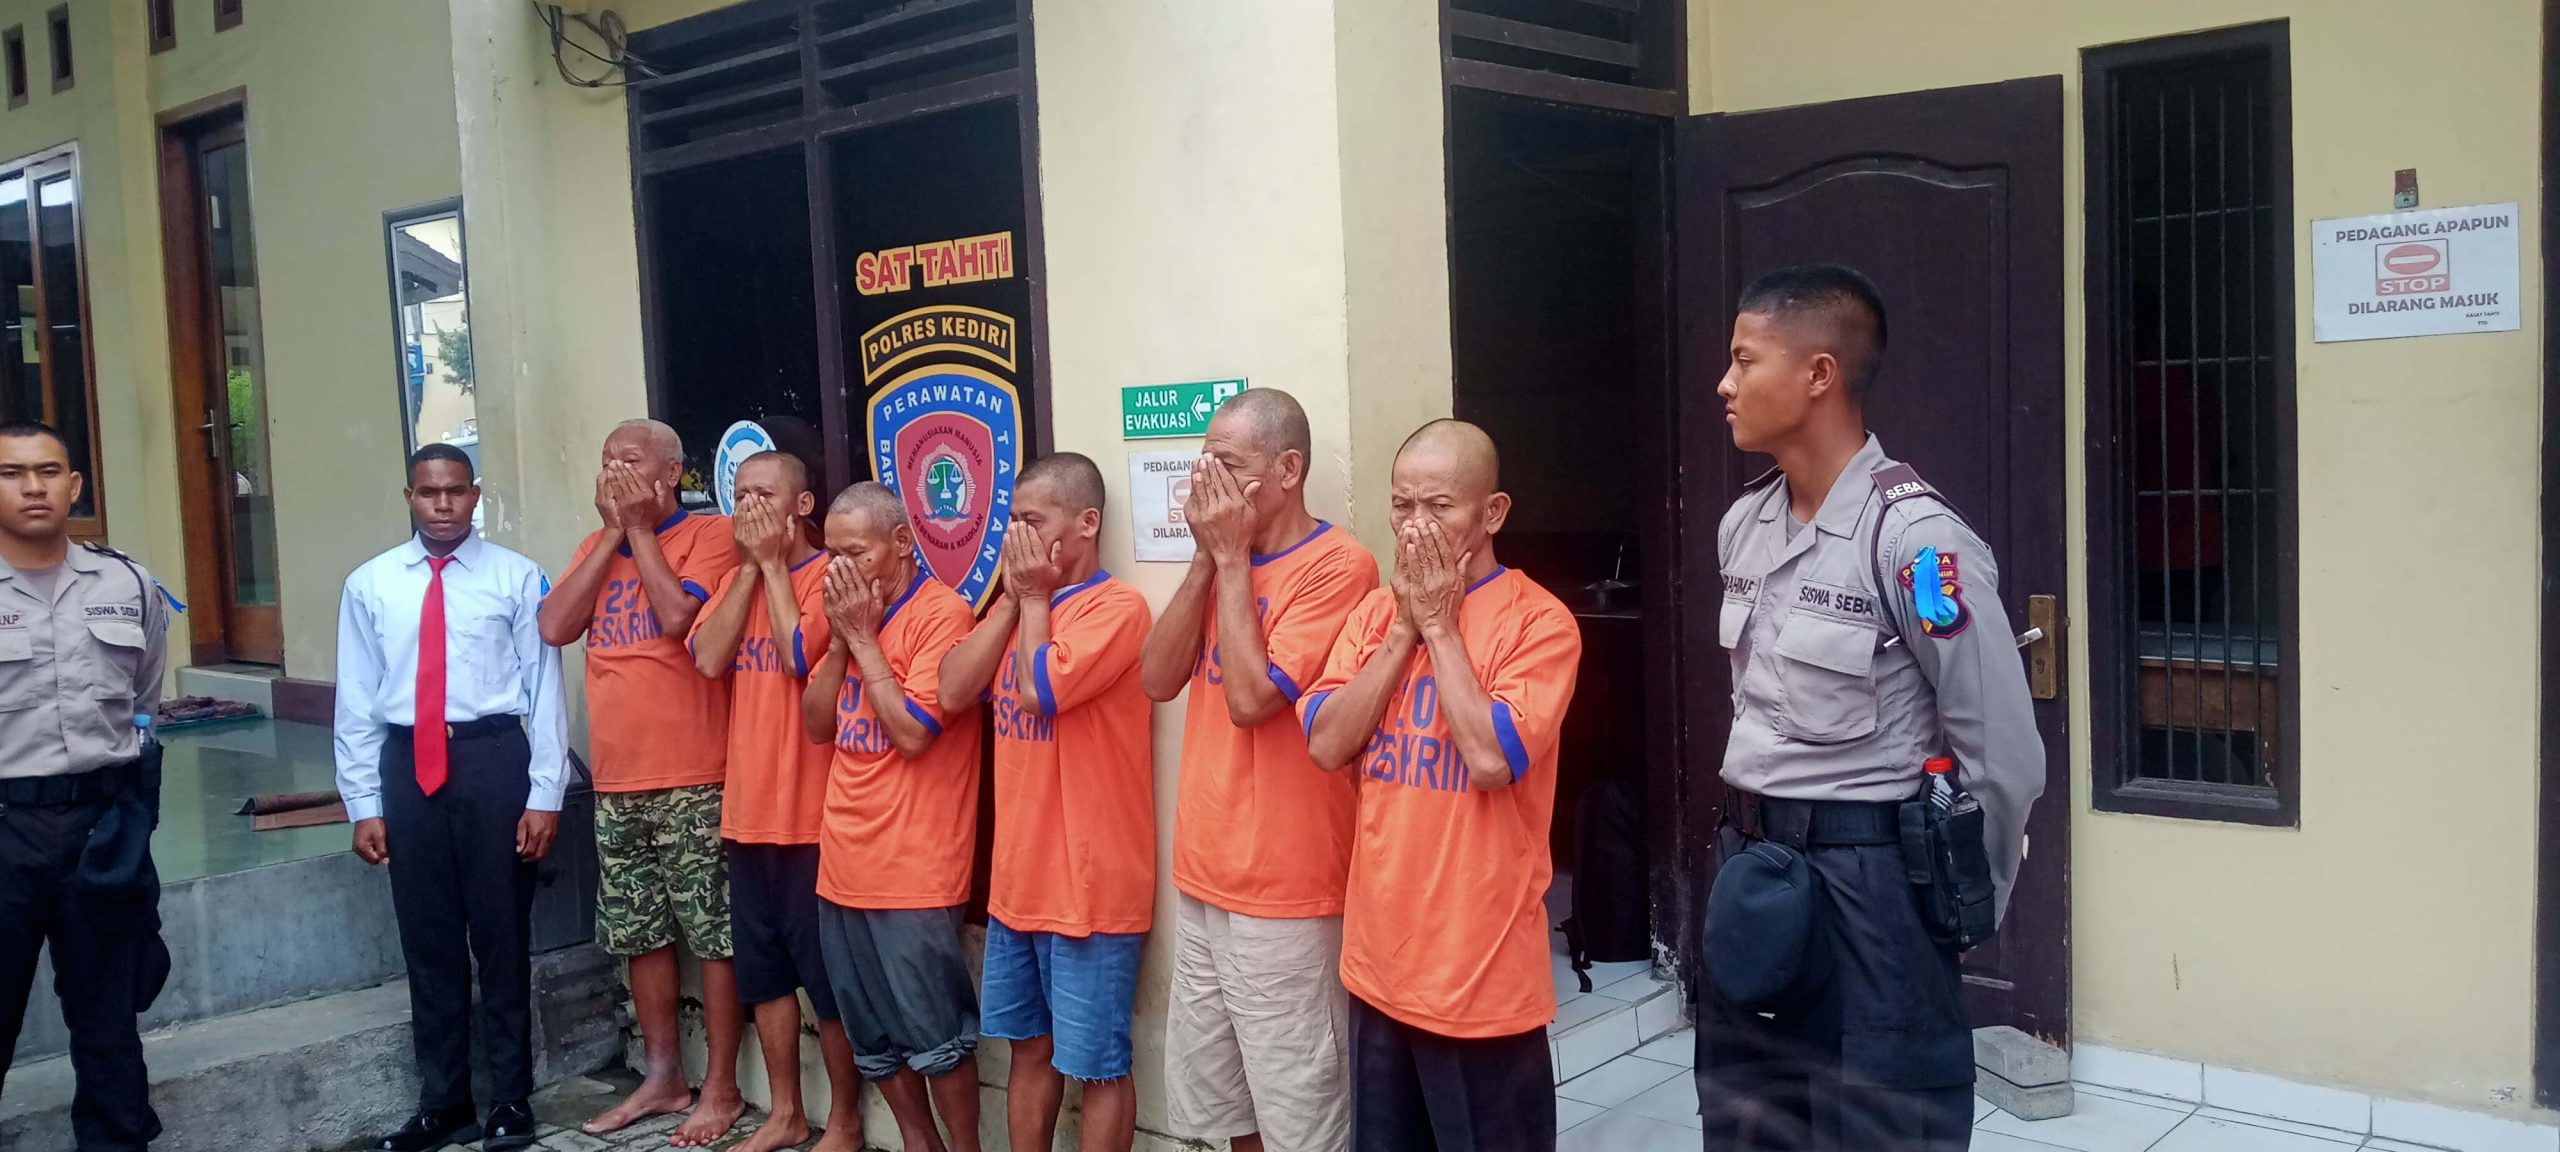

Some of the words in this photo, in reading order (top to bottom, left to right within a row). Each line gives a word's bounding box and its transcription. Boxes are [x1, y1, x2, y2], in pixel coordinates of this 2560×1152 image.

[2335, 223, 2430, 243] PEDAGANG
[2434, 215, 2510, 234] APAPUN
[859, 252, 911, 290] SAT
[920, 238, 1009, 281] TAHTI
[2380, 276, 2446, 294] STOP
[2348, 297, 2435, 315] DILARANG
[2440, 292, 2499, 309] MASUK
[869, 318, 936, 363] POLRES
[942, 316, 1007, 349] KEDIRI
[883, 385, 1003, 422] PERAWATAN
[1135, 390, 1178, 408] JALUR
[1126, 412, 1191, 430] EVAKUASI
[1144, 460, 1193, 472] PEDAGAN
[1886, 481, 1924, 499] SEBA
[957, 513, 984, 548] KEADILAN
[1153, 527, 1192, 539] DILARA
[1799, 585, 1830, 608] SISWA
[1834, 593, 1874, 616] SEBA
[84, 607, 118, 617] SISWA
[120, 607, 139, 617] SEBA
